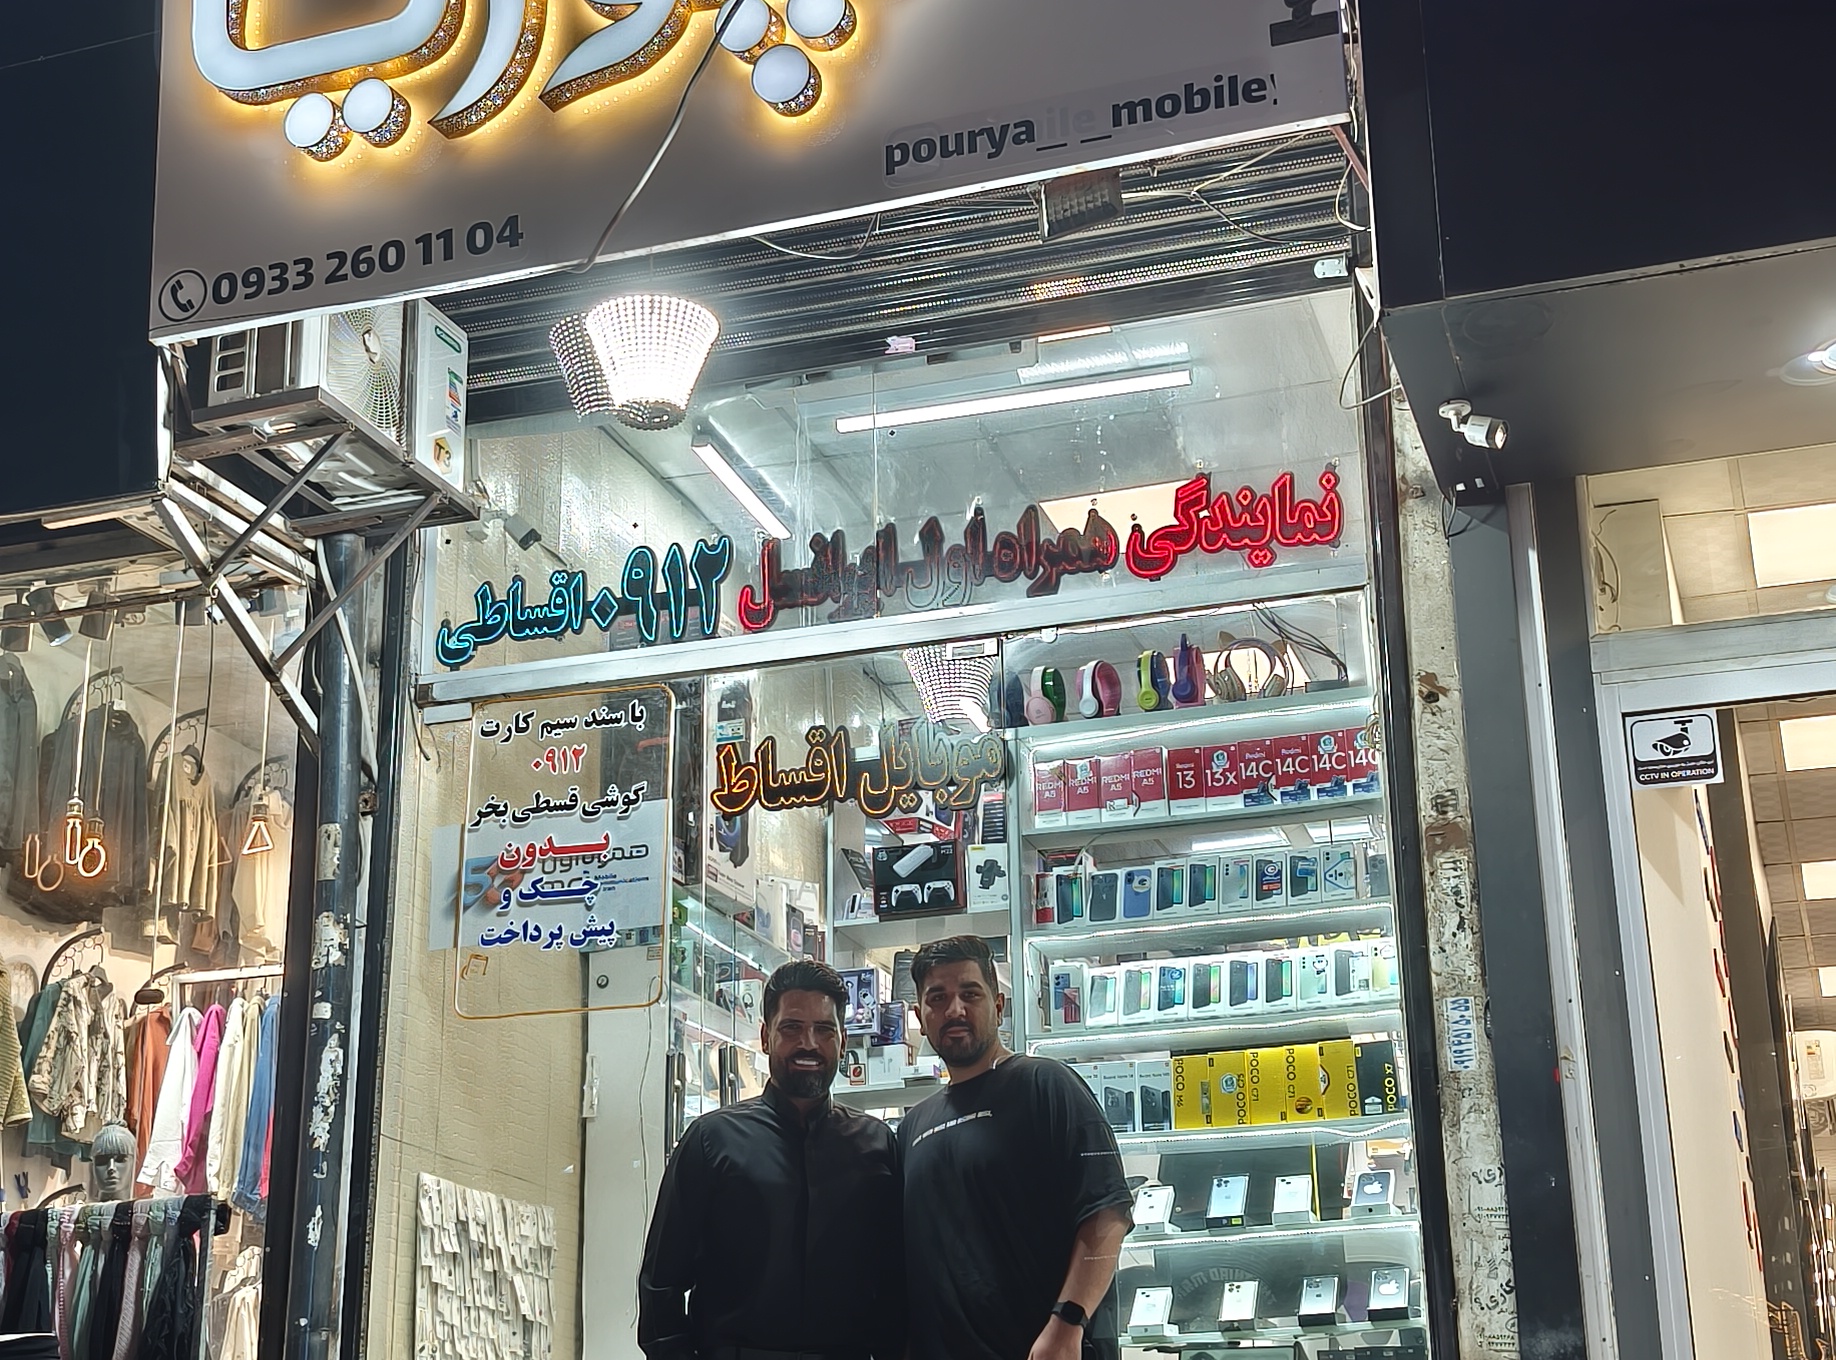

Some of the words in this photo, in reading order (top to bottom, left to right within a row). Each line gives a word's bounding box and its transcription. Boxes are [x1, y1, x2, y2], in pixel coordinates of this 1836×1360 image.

[210, 256, 314, 308] 0933
[325, 240, 402, 285] 260
[414, 226, 457, 267] 11
[464, 215, 525, 257] 04
[1125, 472, 1342, 580] نمایندگی
[591, 534, 733, 642] ۰۹۱۲
[436, 570, 585, 667] اقساطی
[479, 712, 535, 743] کارت
[540, 714, 578, 740] سیم
[584, 706, 626, 731] سند
[630, 701, 647, 732] با
[530, 744, 587, 775] ۰۹۱۲
[712, 726, 851, 813] اقساط
[860, 721, 1004, 817] موبایل
[1133, 768, 1161, 779] REDMI
[1240, 760, 1274, 779] 14C
[1275, 756, 1310, 775] 14C
[1311, 752, 1347, 772] 14C
[1639, 773, 1659, 781] CCTV
[1660, 771, 1670, 779] IN
[1670, 767, 1715, 778] OPERATION
[1101, 774, 1130, 784] REDMI
[1177, 771, 1196, 789] 13
[1206, 769, 1238, 787] 13x
[470, 794, 509, 826] بخر
[511, 787, 579, 823] قسطی
[582, 781, 647, 816] گوشی
[498, 832, 611, 869] بدون
[499, 888, 512, 910] و
[569, 915, 616, 946] پیش
[1250, 1052, 1260, 1085] POCO
[1285, 1048, 1296, 1081] POCO
[1237, 1091, 1247, 1125] POCO
[1346, 1083, 1359, 1116] POCO
[1384, 1077, 1397, 1111] POCO
